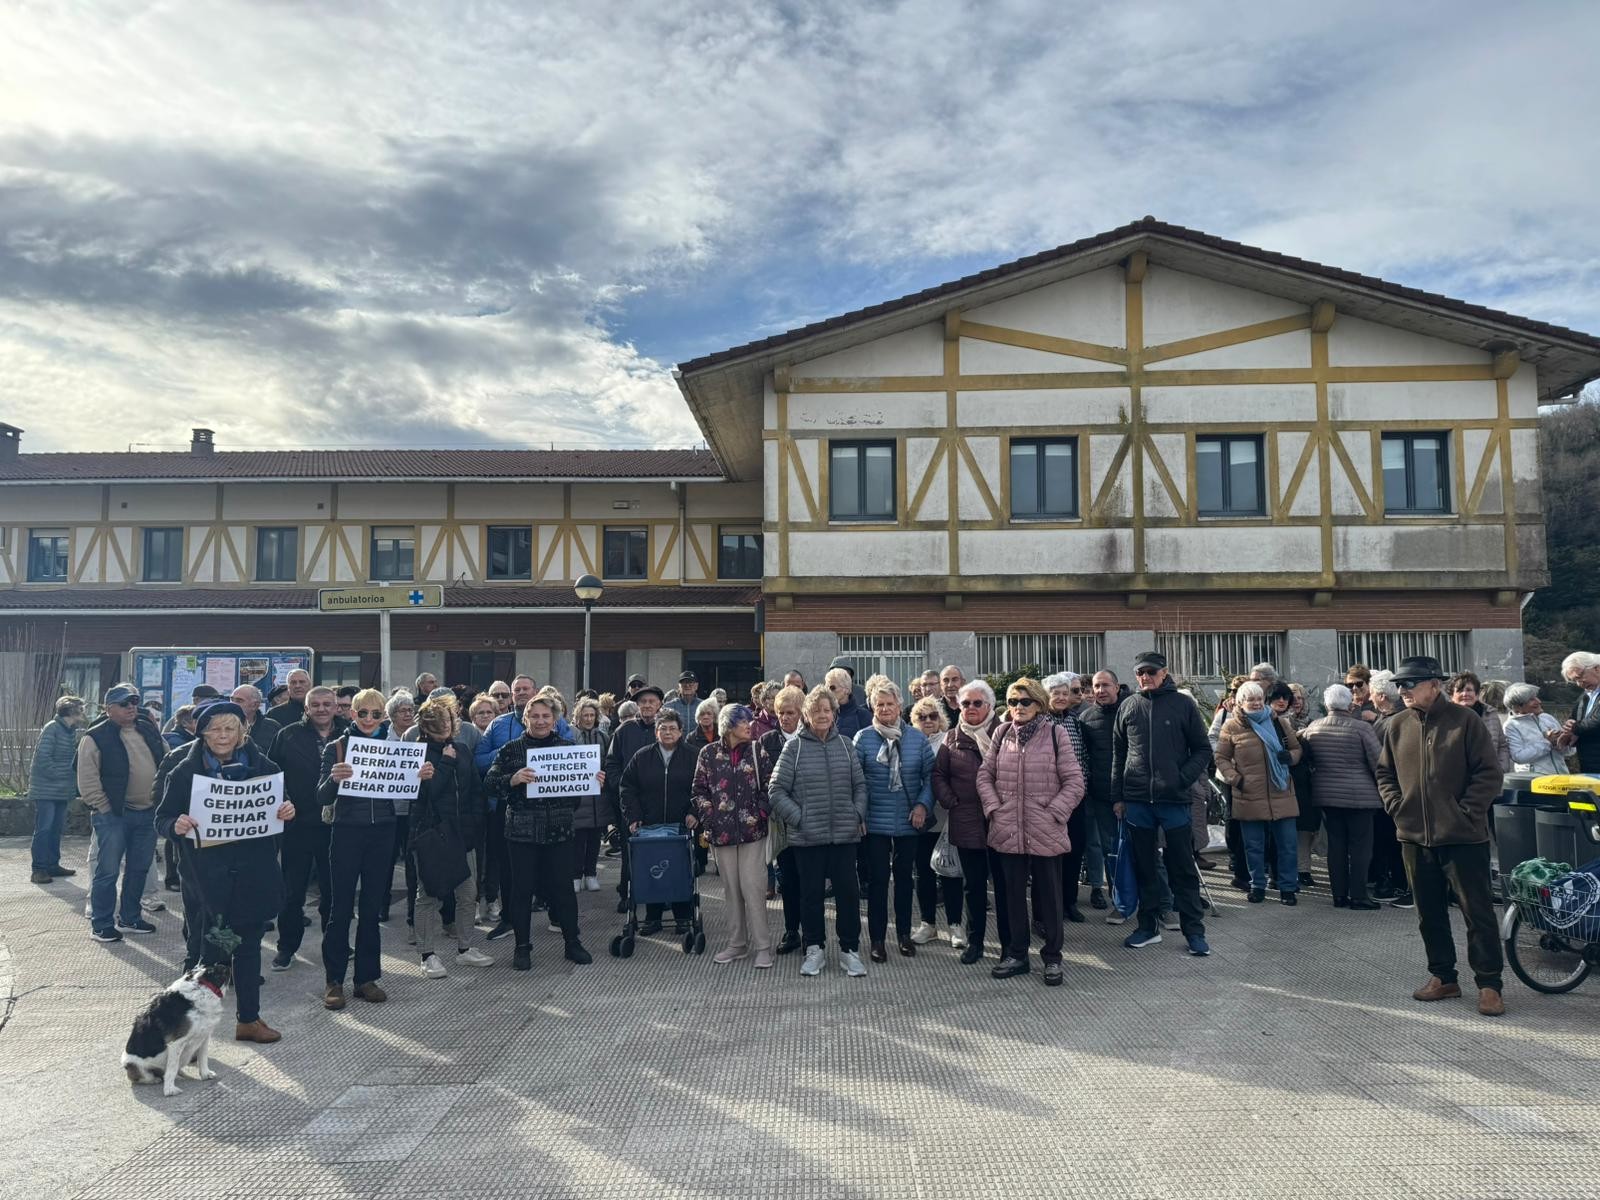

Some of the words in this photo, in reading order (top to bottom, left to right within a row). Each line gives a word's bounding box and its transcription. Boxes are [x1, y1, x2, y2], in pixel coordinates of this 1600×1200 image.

[328, 595, 385, 605] anbulatorioa
[351, 744, 424, 757] ANBULATEGI
[530, 751, 597, 762] ANBULATEGI
[352, 757, 397, 768] BERRIA
[400, 761, 420, 769] ETA
[541, 762, 587, 771] “TERCER
[360, 770, 405, 781] HANDIA
[210, 781, 272, 795] MEDIKU
[342, 781, 385, 792] BEHAR
[387, 785, 418, 793] DUGU
[538, 784, 589, 793] DAUKAGU
[203, 795, 276, 809] GEHIAGO
[211, 812, 266, 823] BEHAR
[206, 825, 268, 838] DITUGU
